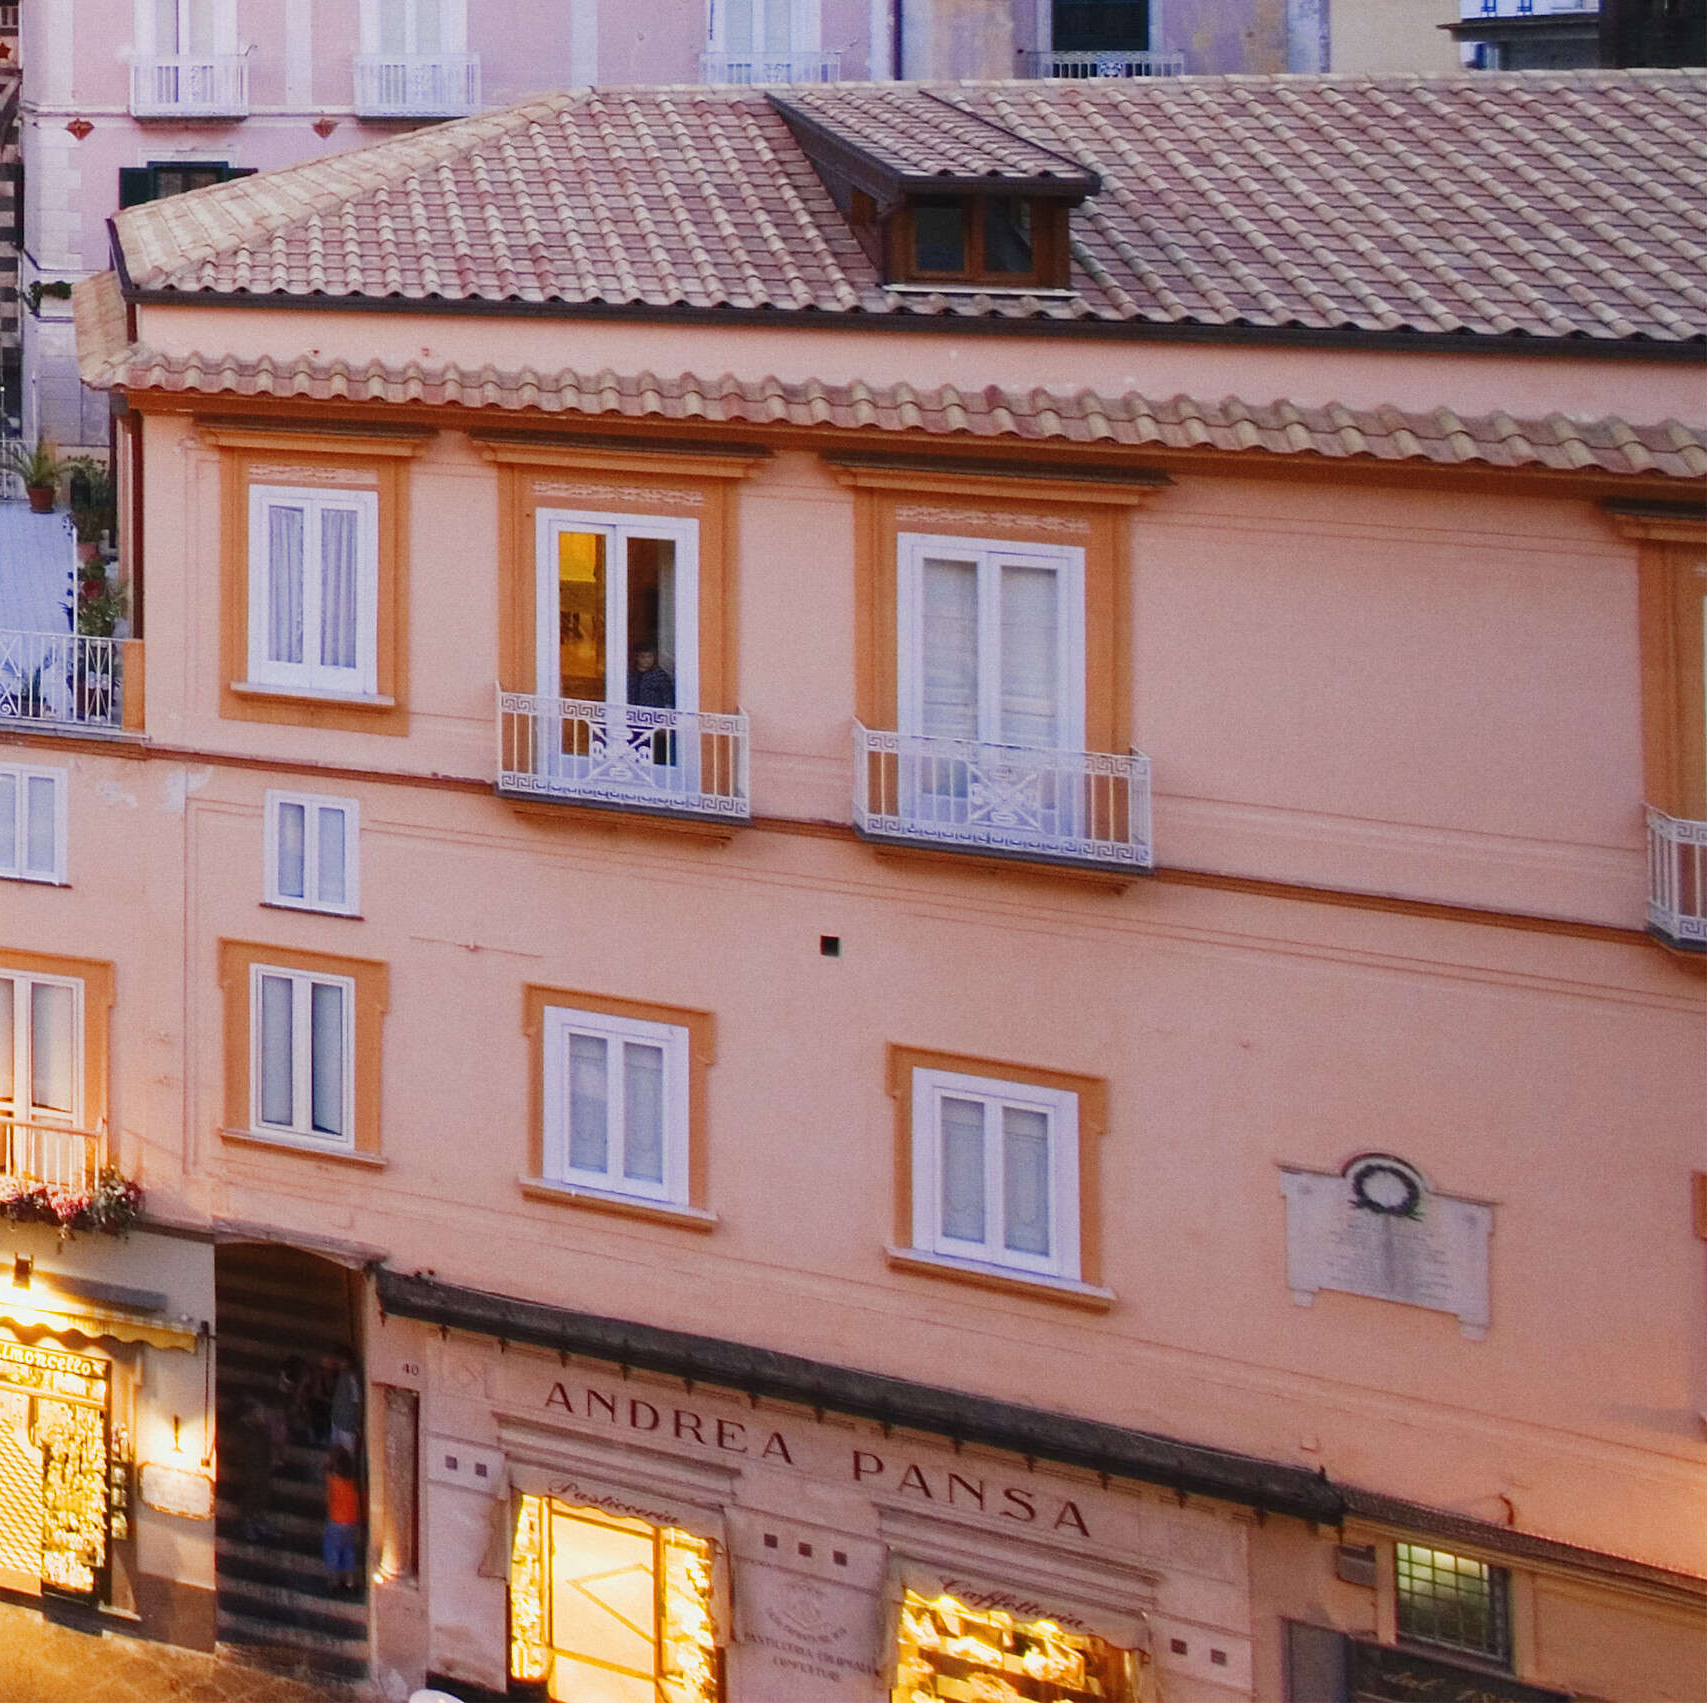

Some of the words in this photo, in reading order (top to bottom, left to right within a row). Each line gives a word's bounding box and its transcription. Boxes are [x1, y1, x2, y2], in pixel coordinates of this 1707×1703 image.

[545, 1381, 795, 1466] ANDREA
[852, 1451, 1092, 1538] PANSA
[547, 1478, 681, 1525] Pasticceria
